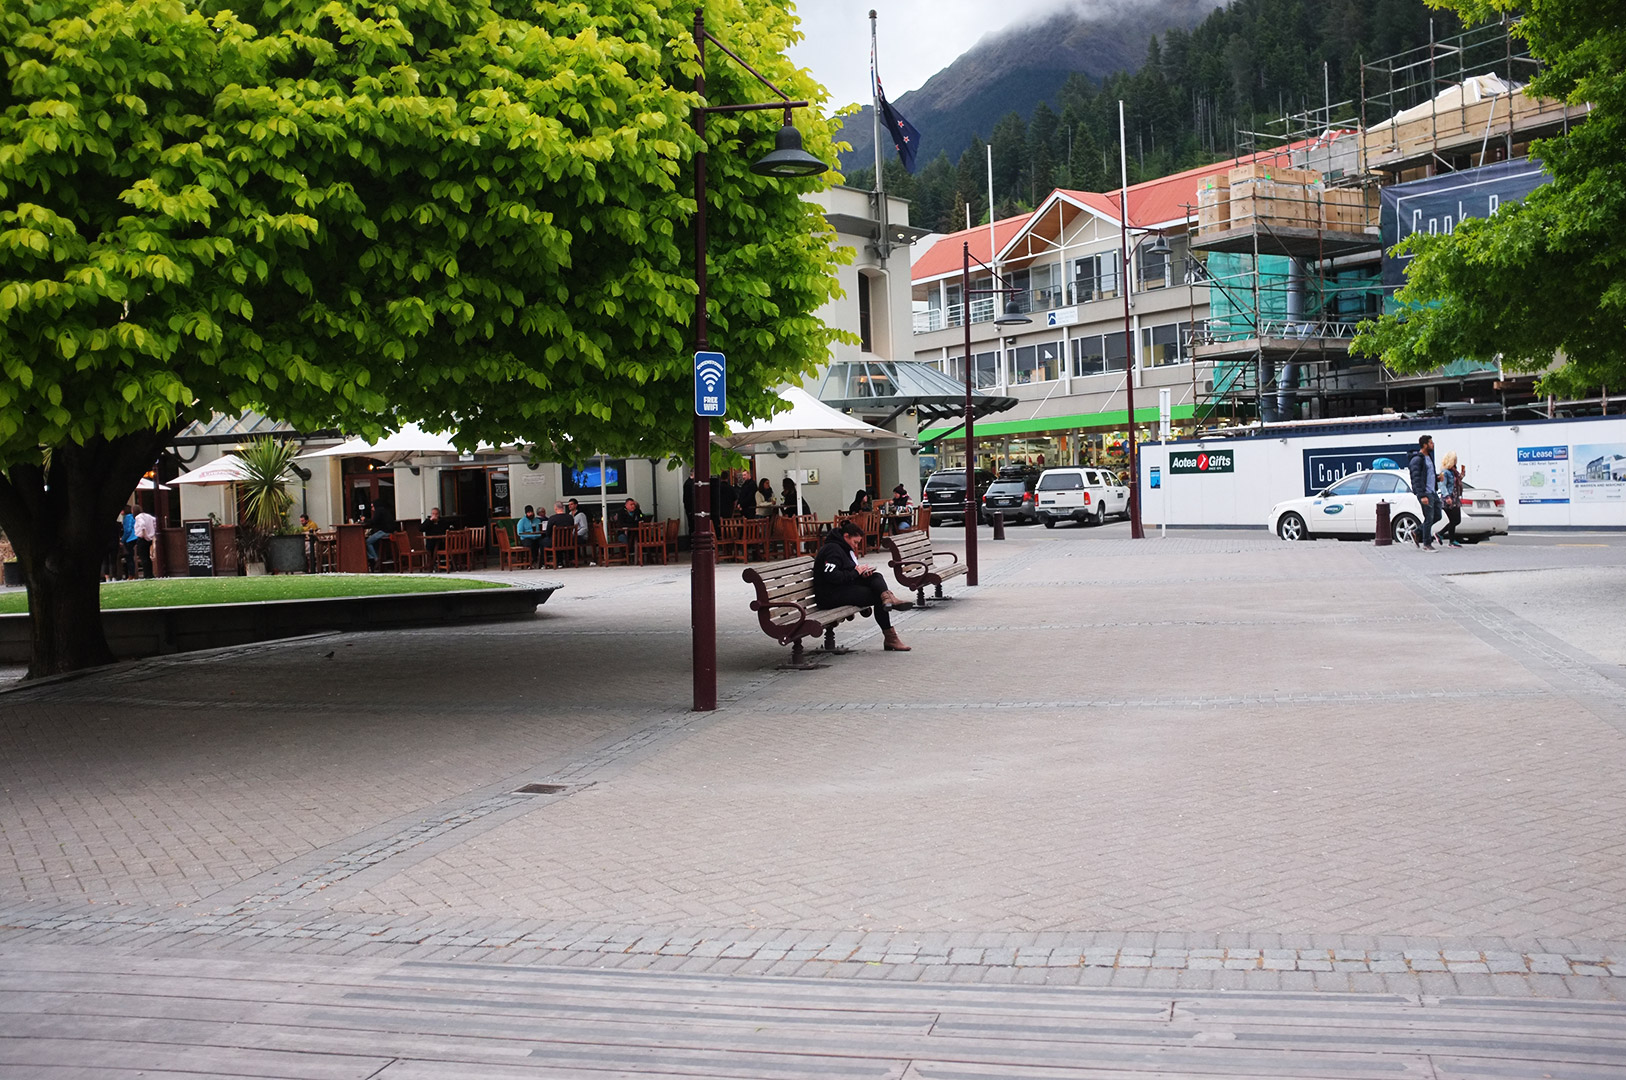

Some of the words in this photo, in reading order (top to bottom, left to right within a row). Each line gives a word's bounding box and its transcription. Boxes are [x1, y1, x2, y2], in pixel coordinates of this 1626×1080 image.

[1518, 450, 1530, 459] For
[1532, 449, 1553, 458] Lease
[1172, 457, 1197, 468] Aotea
[1208, 456, 1231, 467] Gifts
[1318, 463, 1347, 482] Cook
[824, 562, 836, 572] 77
